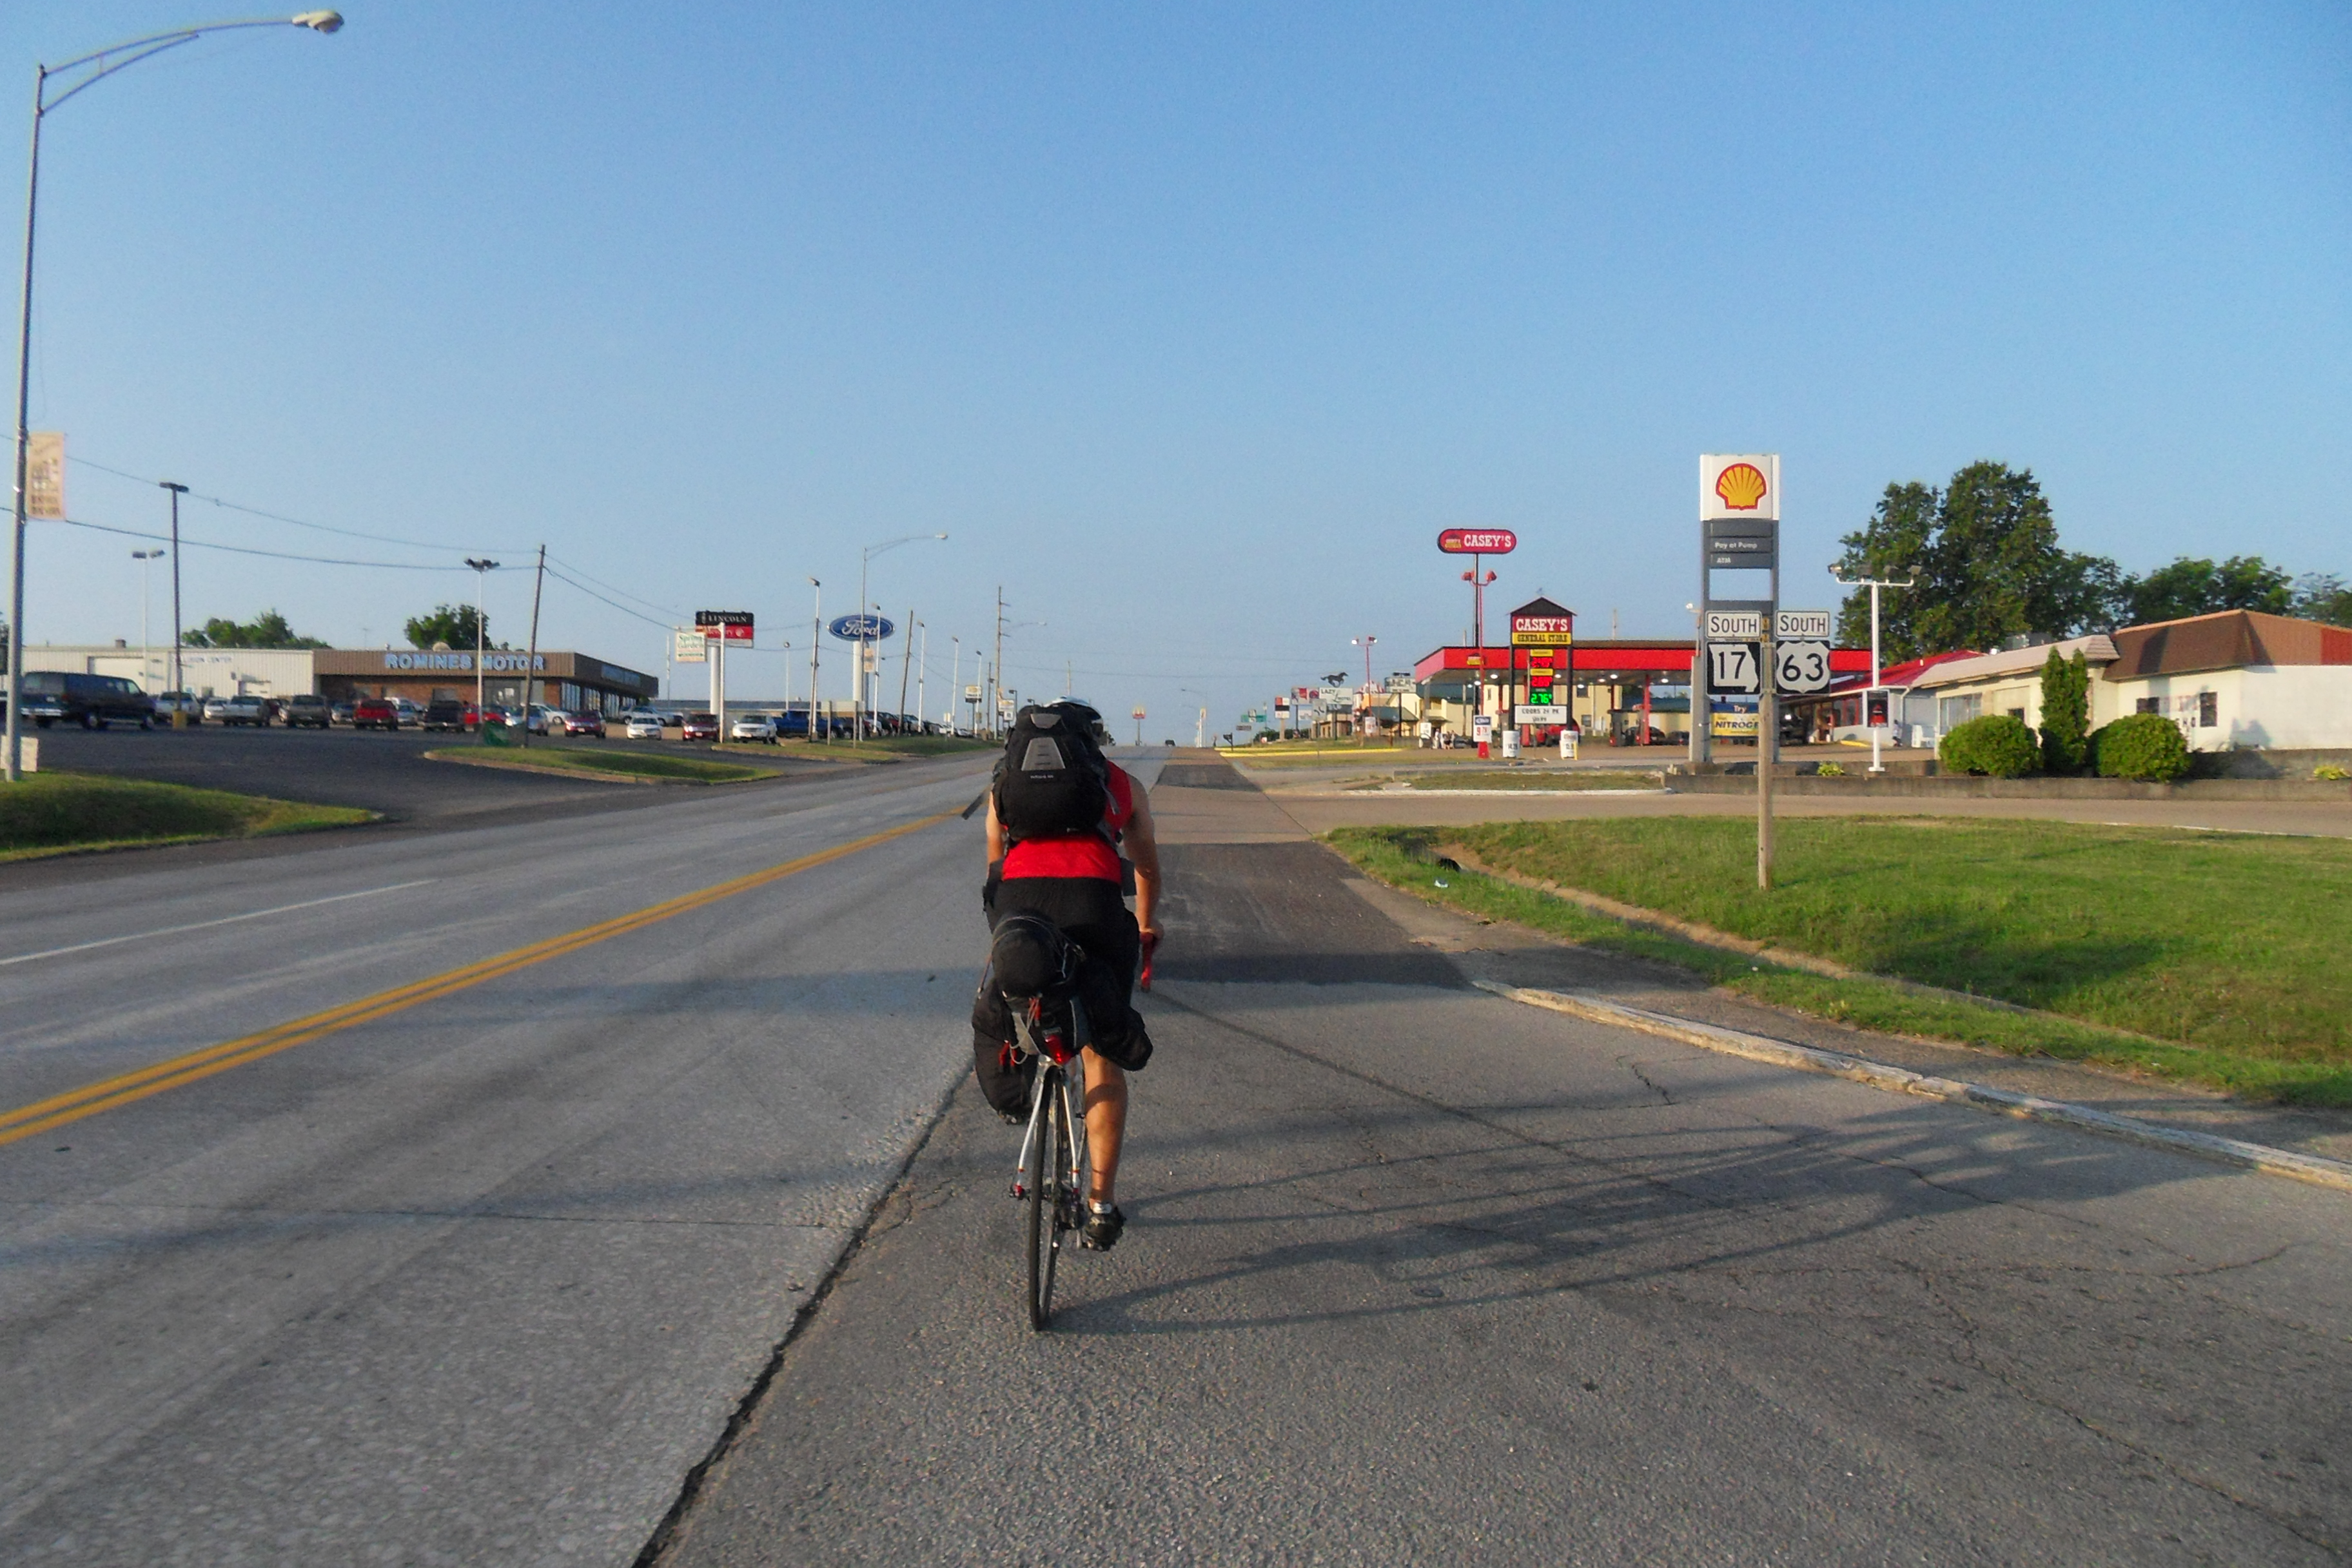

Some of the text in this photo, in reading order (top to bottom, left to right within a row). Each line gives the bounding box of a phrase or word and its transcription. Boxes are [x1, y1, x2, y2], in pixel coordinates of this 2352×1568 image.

[1464, 534, 1512, 547] CASEY'S
[841, 620, 879, 636] Ford
[1516, 618, 1568, 631] CASEY'S
[1710, 616, 1758, 633] SOUTH
[1779, 614, 1826, 632] SOUTH
[385, 653, 544, 671] ROMINES MOTOR
[1718, 651, 1747, 680] 17
[1782, 652, 1824, 682] 63
